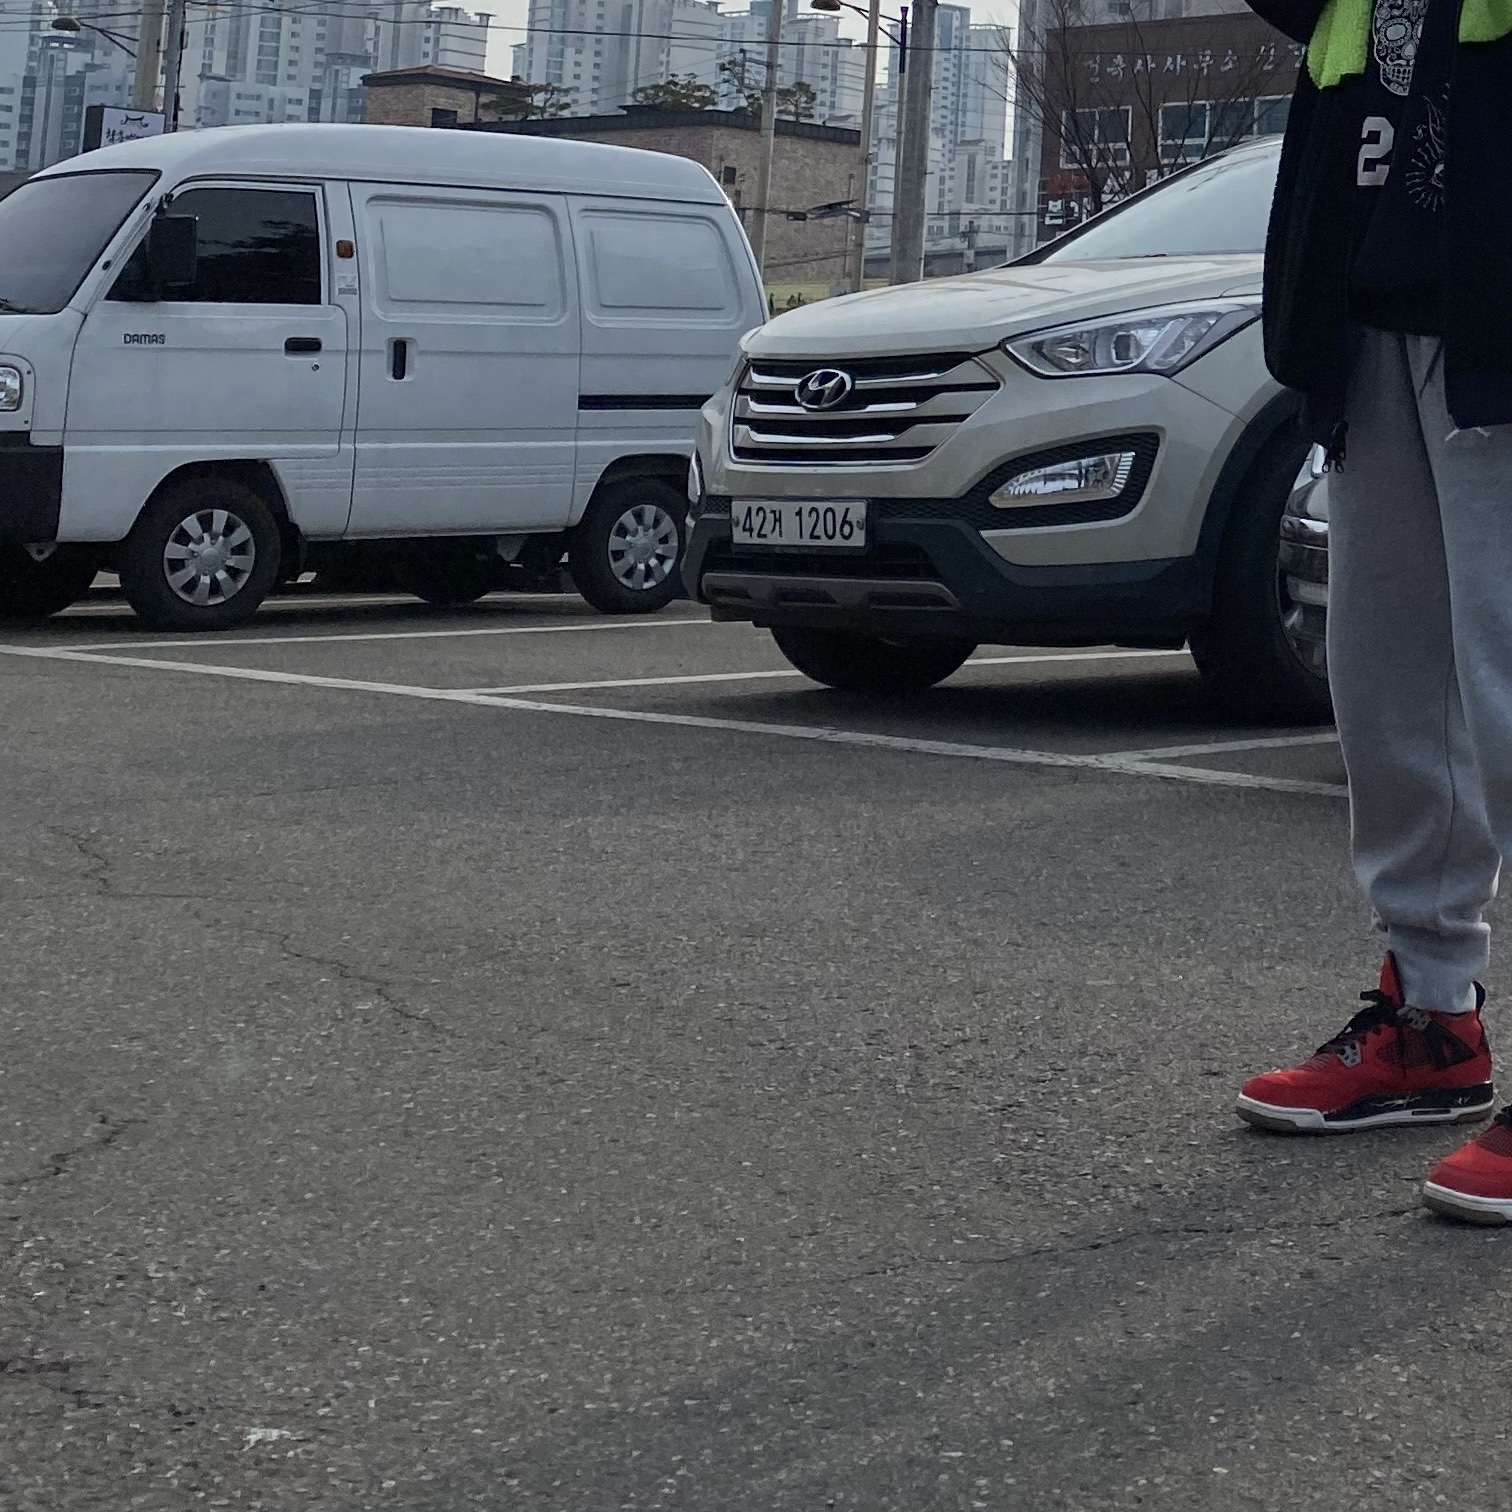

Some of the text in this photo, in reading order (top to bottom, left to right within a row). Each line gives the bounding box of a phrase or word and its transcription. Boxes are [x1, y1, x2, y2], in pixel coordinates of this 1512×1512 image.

[1356, 116, 1395, 186] 2
[123, 332, 166, 345] DAMAS
[741, 506, 855, 541] 42거 1206
